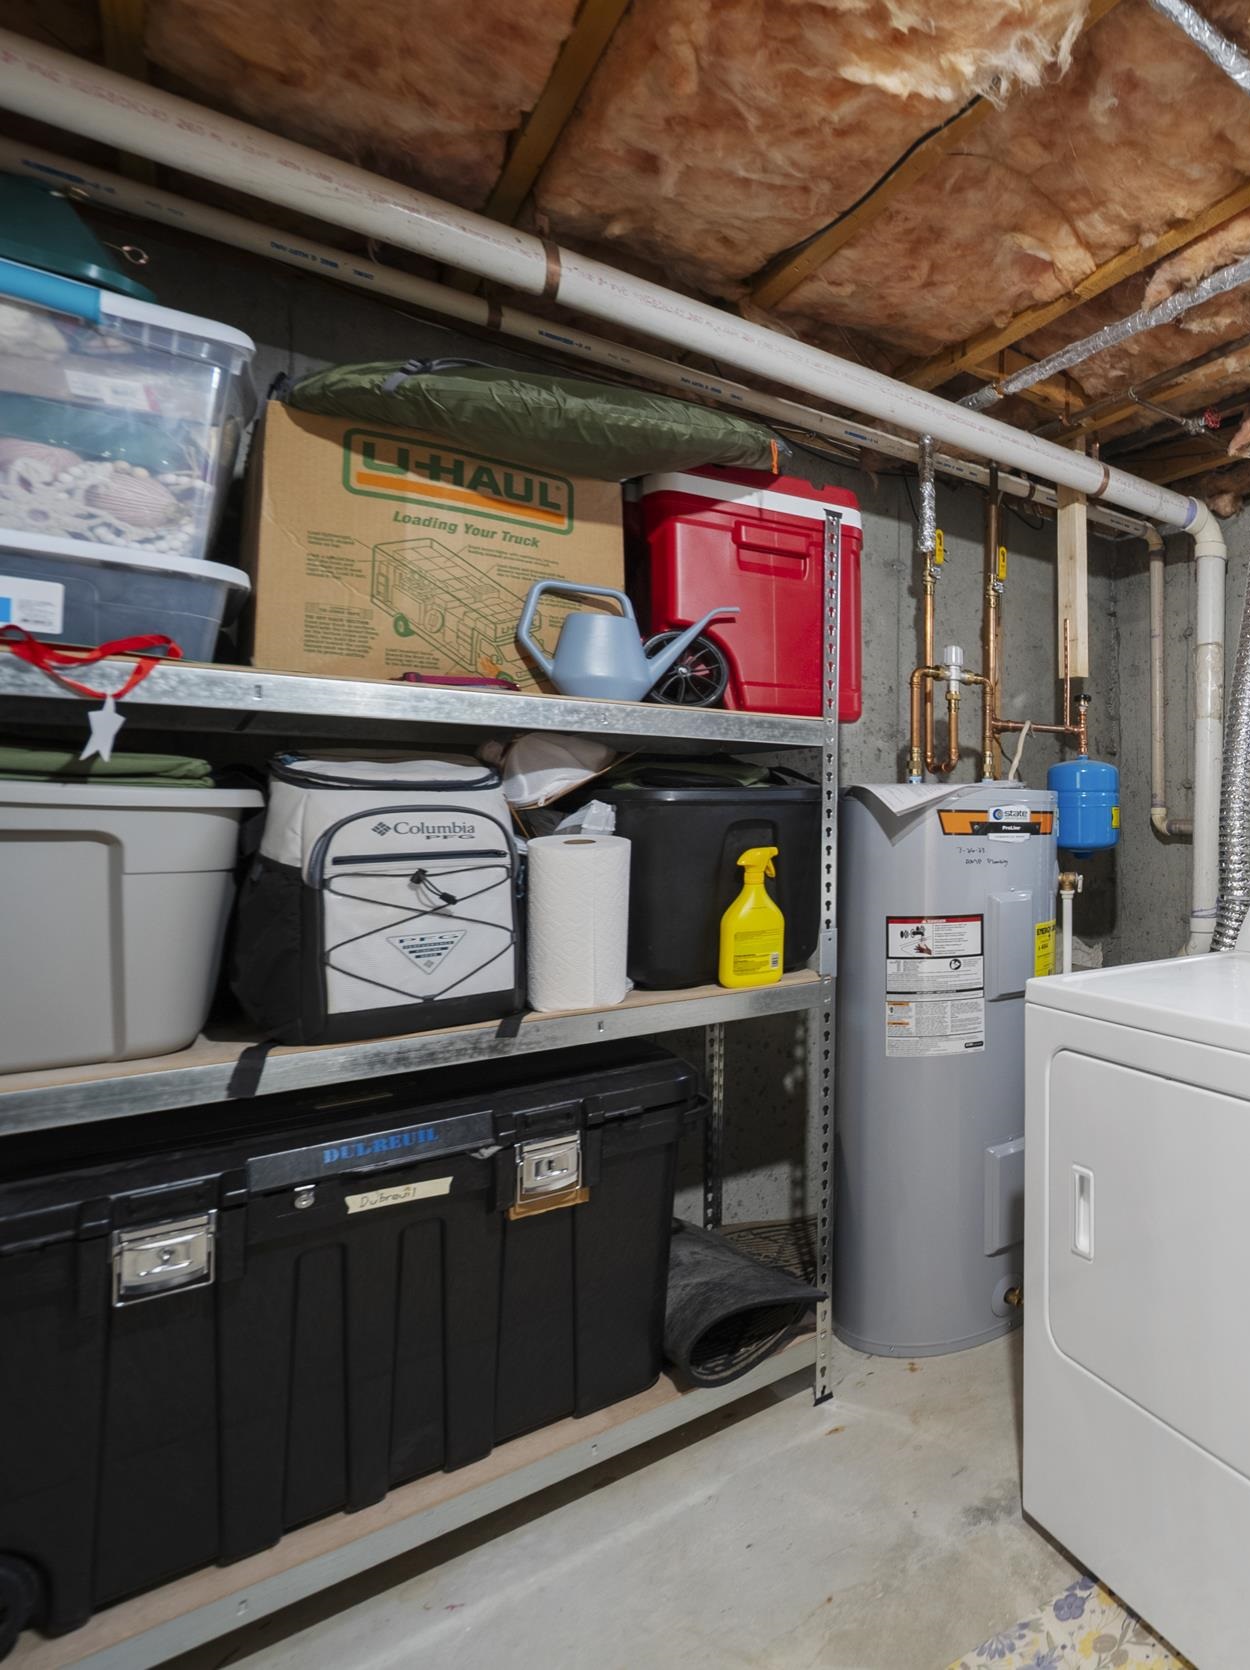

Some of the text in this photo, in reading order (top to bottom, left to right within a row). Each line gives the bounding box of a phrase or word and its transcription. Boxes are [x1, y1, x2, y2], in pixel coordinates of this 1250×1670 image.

[363, 441, 561, 511] U-HAUL
[393, 511, 540, 548] Loading Your Truck
[1004, 809, 1028, 818] state
[394, 822, 476, 835] Columbia
[358, 1185, 418, 1208] Dubreuil
